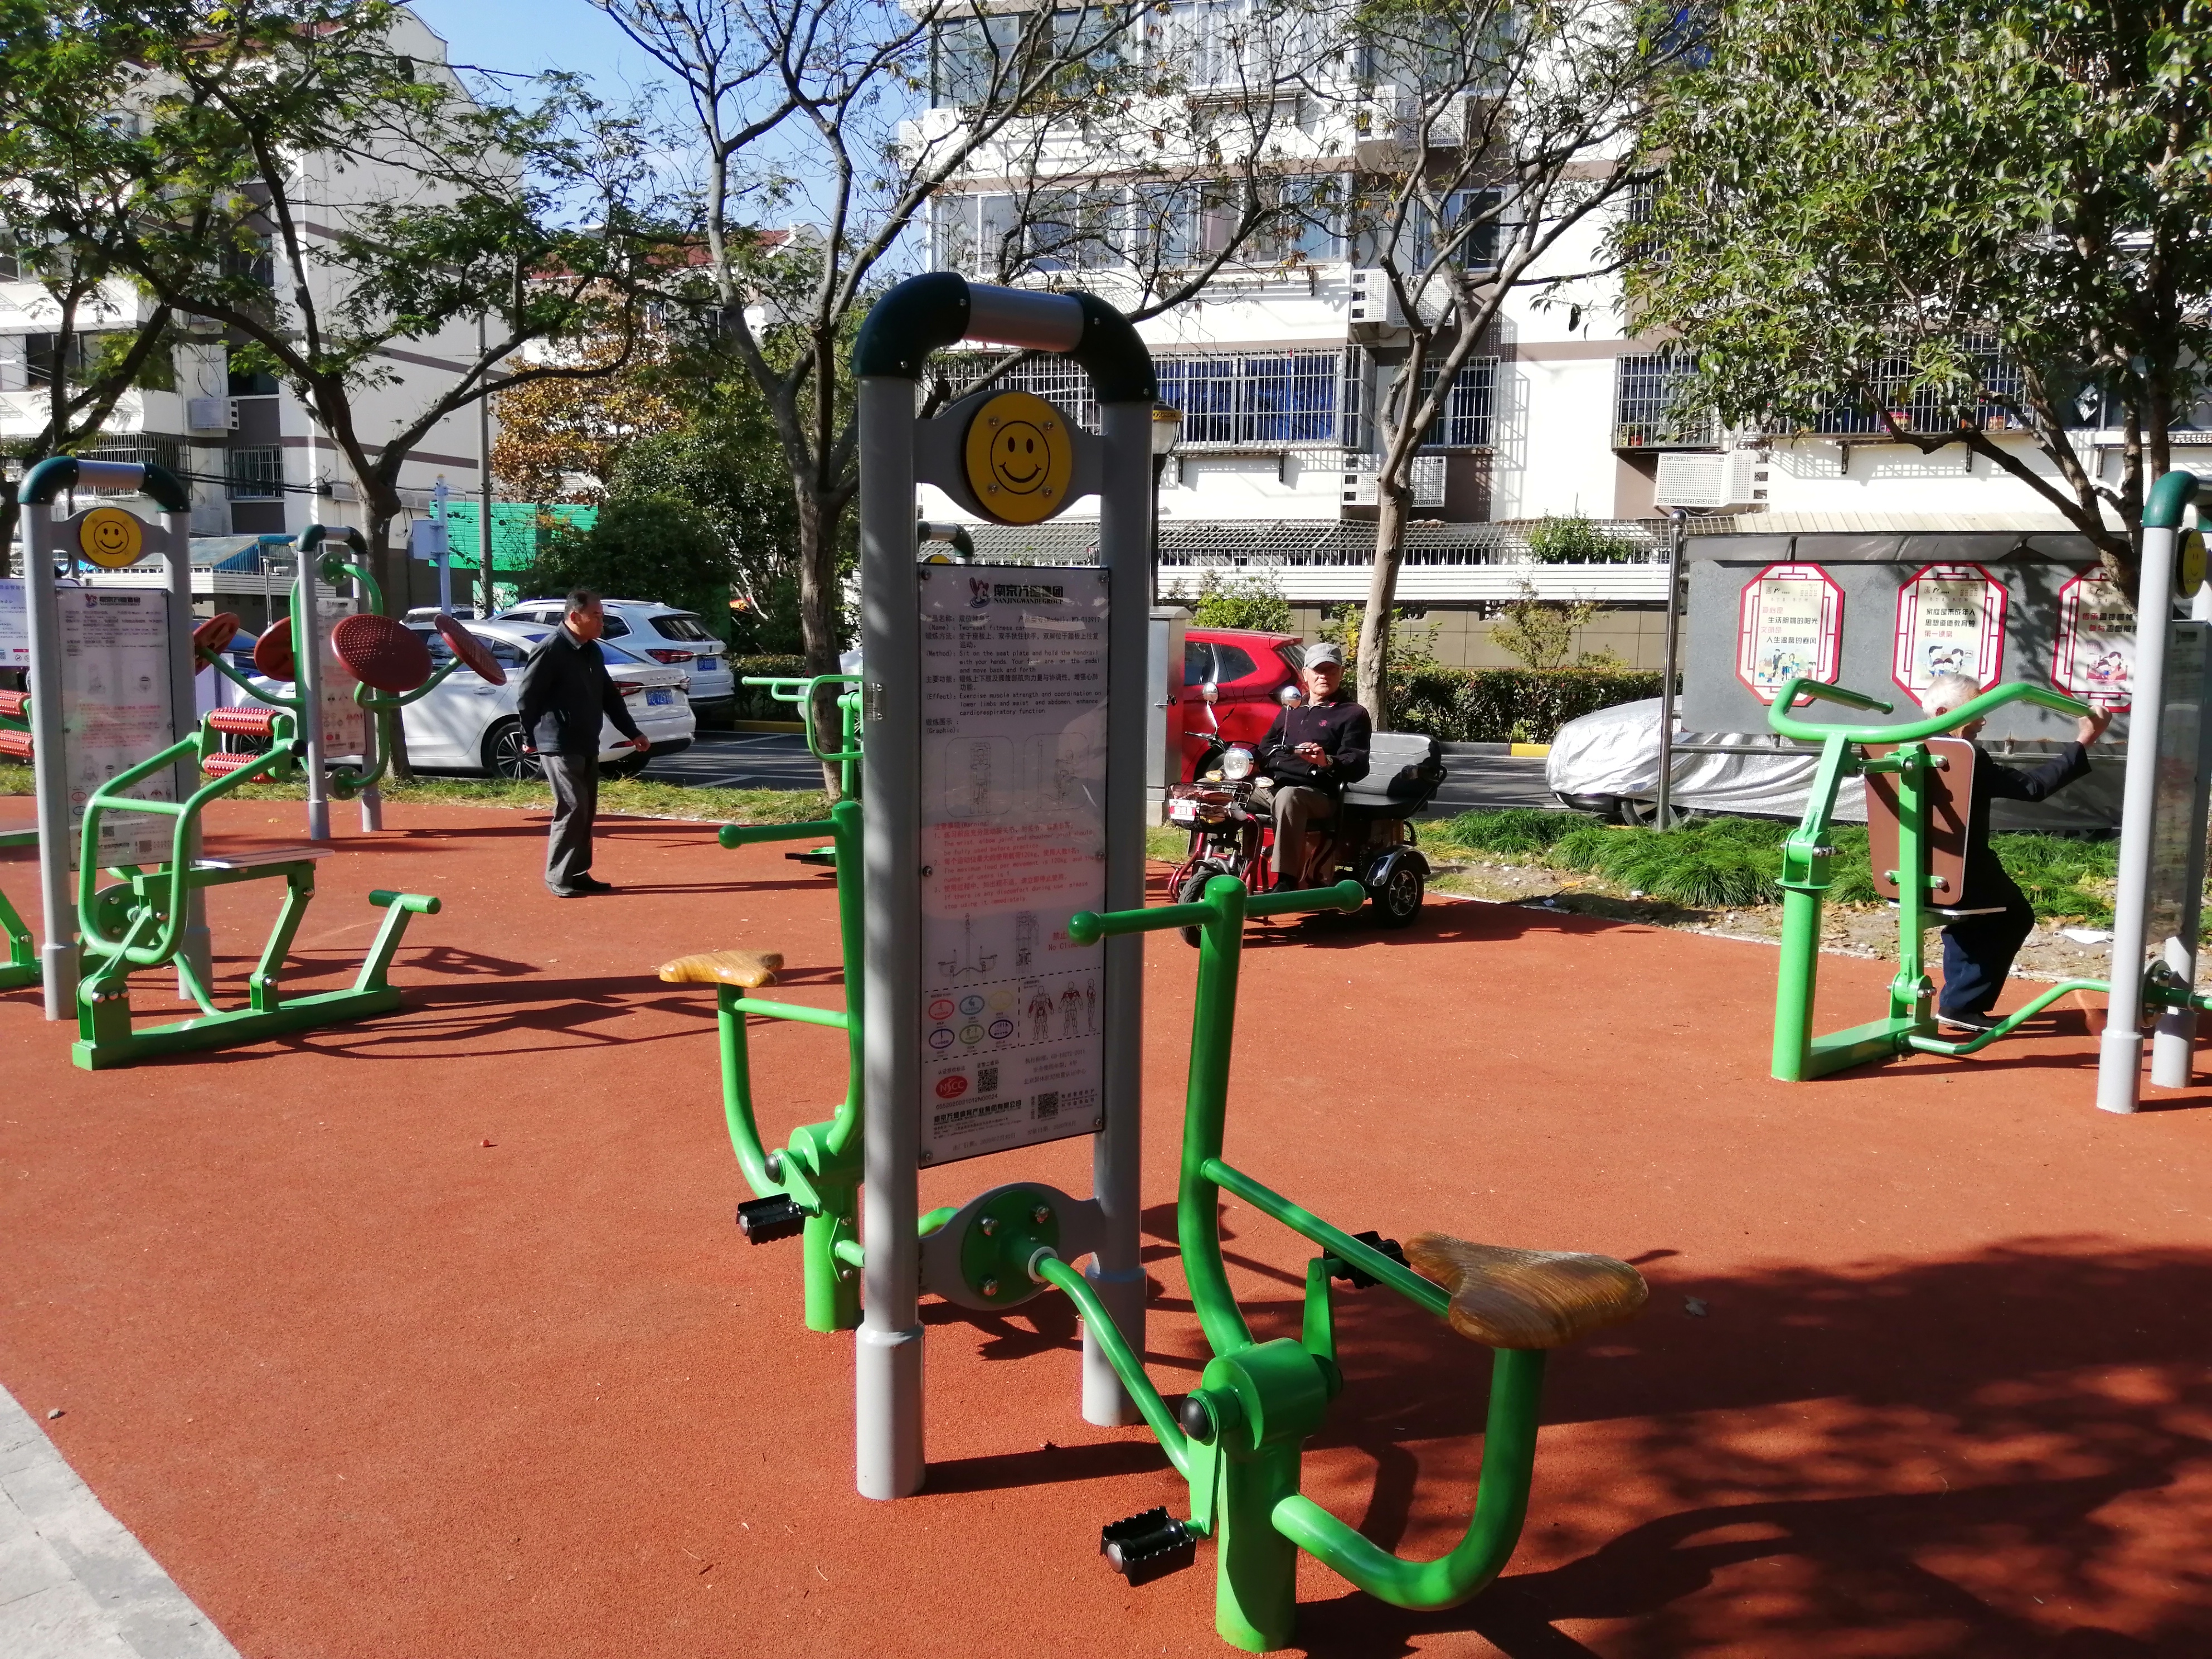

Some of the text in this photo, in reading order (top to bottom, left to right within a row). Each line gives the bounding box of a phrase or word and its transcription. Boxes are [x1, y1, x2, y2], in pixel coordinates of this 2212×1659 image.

[1925, 619, 1976, 627] 思想道德教育的
[996, 886, 1029, 895] discomfort
[1069, 880, 1089, 889] please
